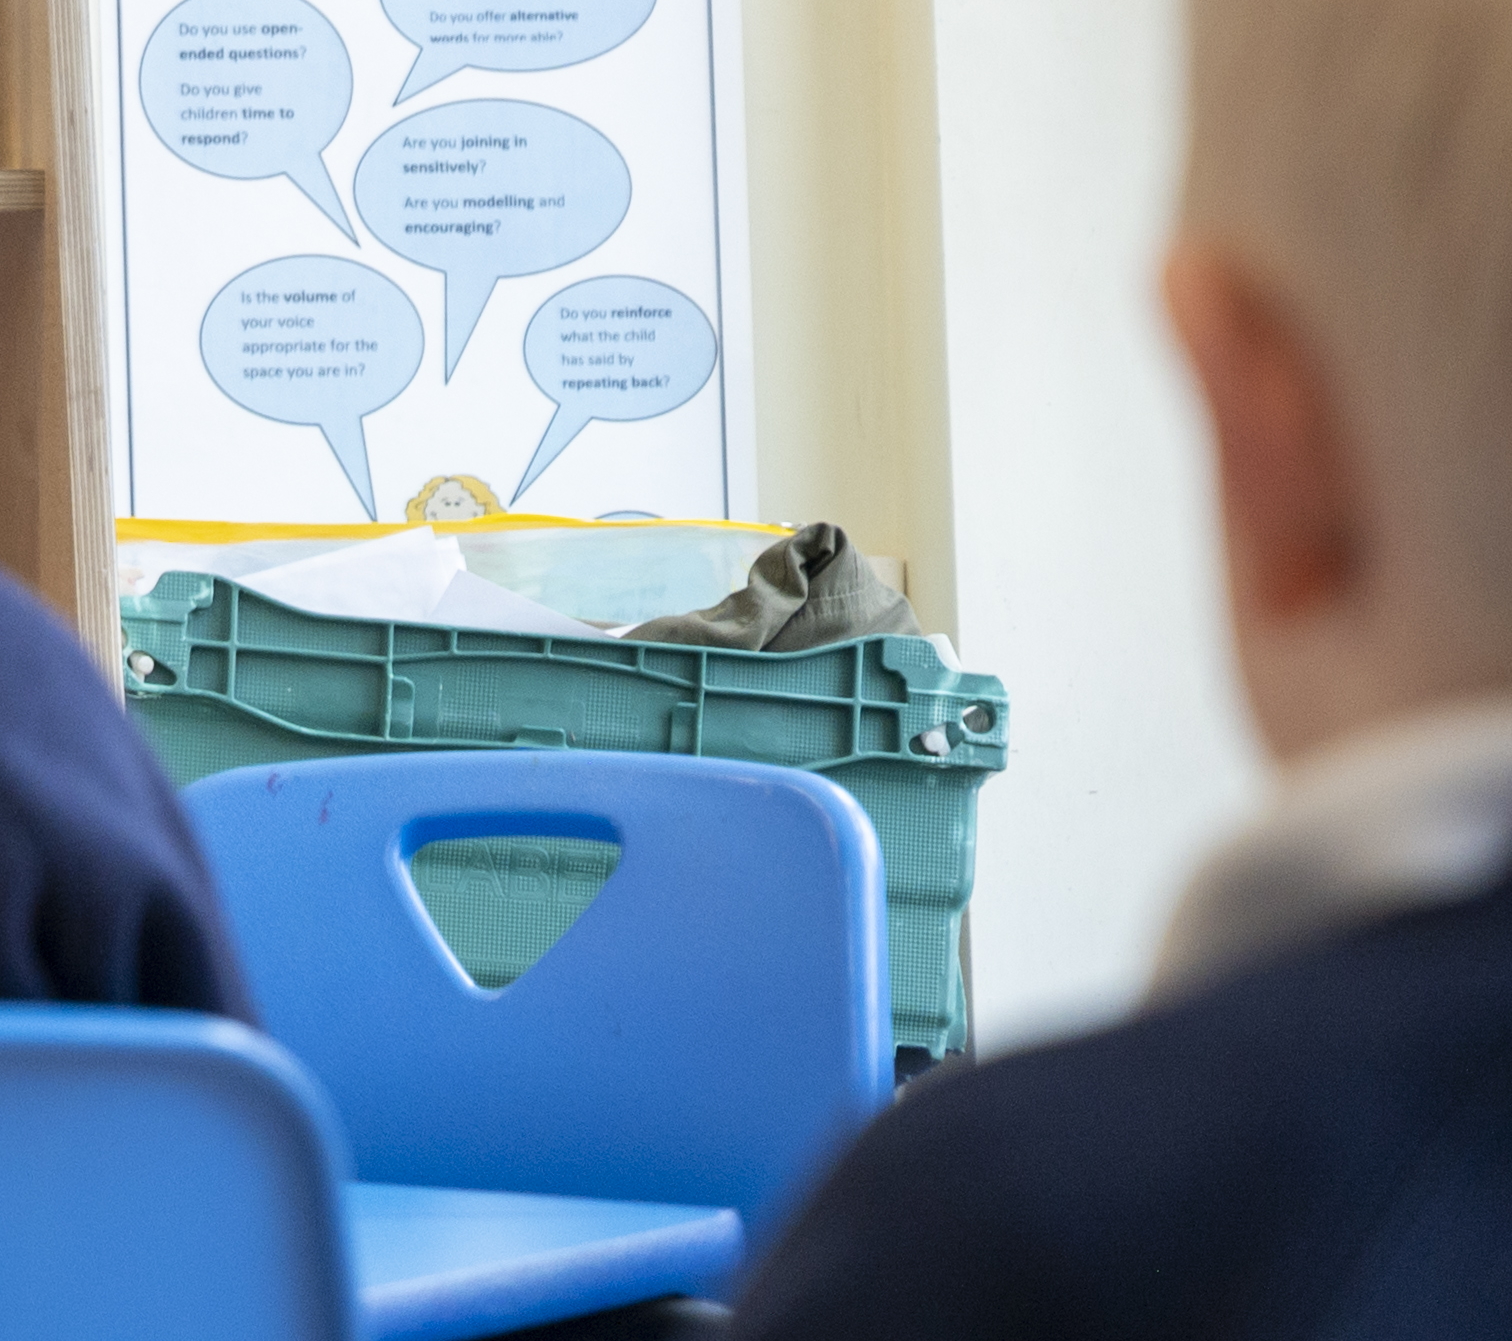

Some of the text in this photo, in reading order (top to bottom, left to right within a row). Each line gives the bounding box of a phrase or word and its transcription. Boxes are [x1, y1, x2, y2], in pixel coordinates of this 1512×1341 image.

[178, 46, 225, 61] ended
[179, 107, 295, 120] children time to
